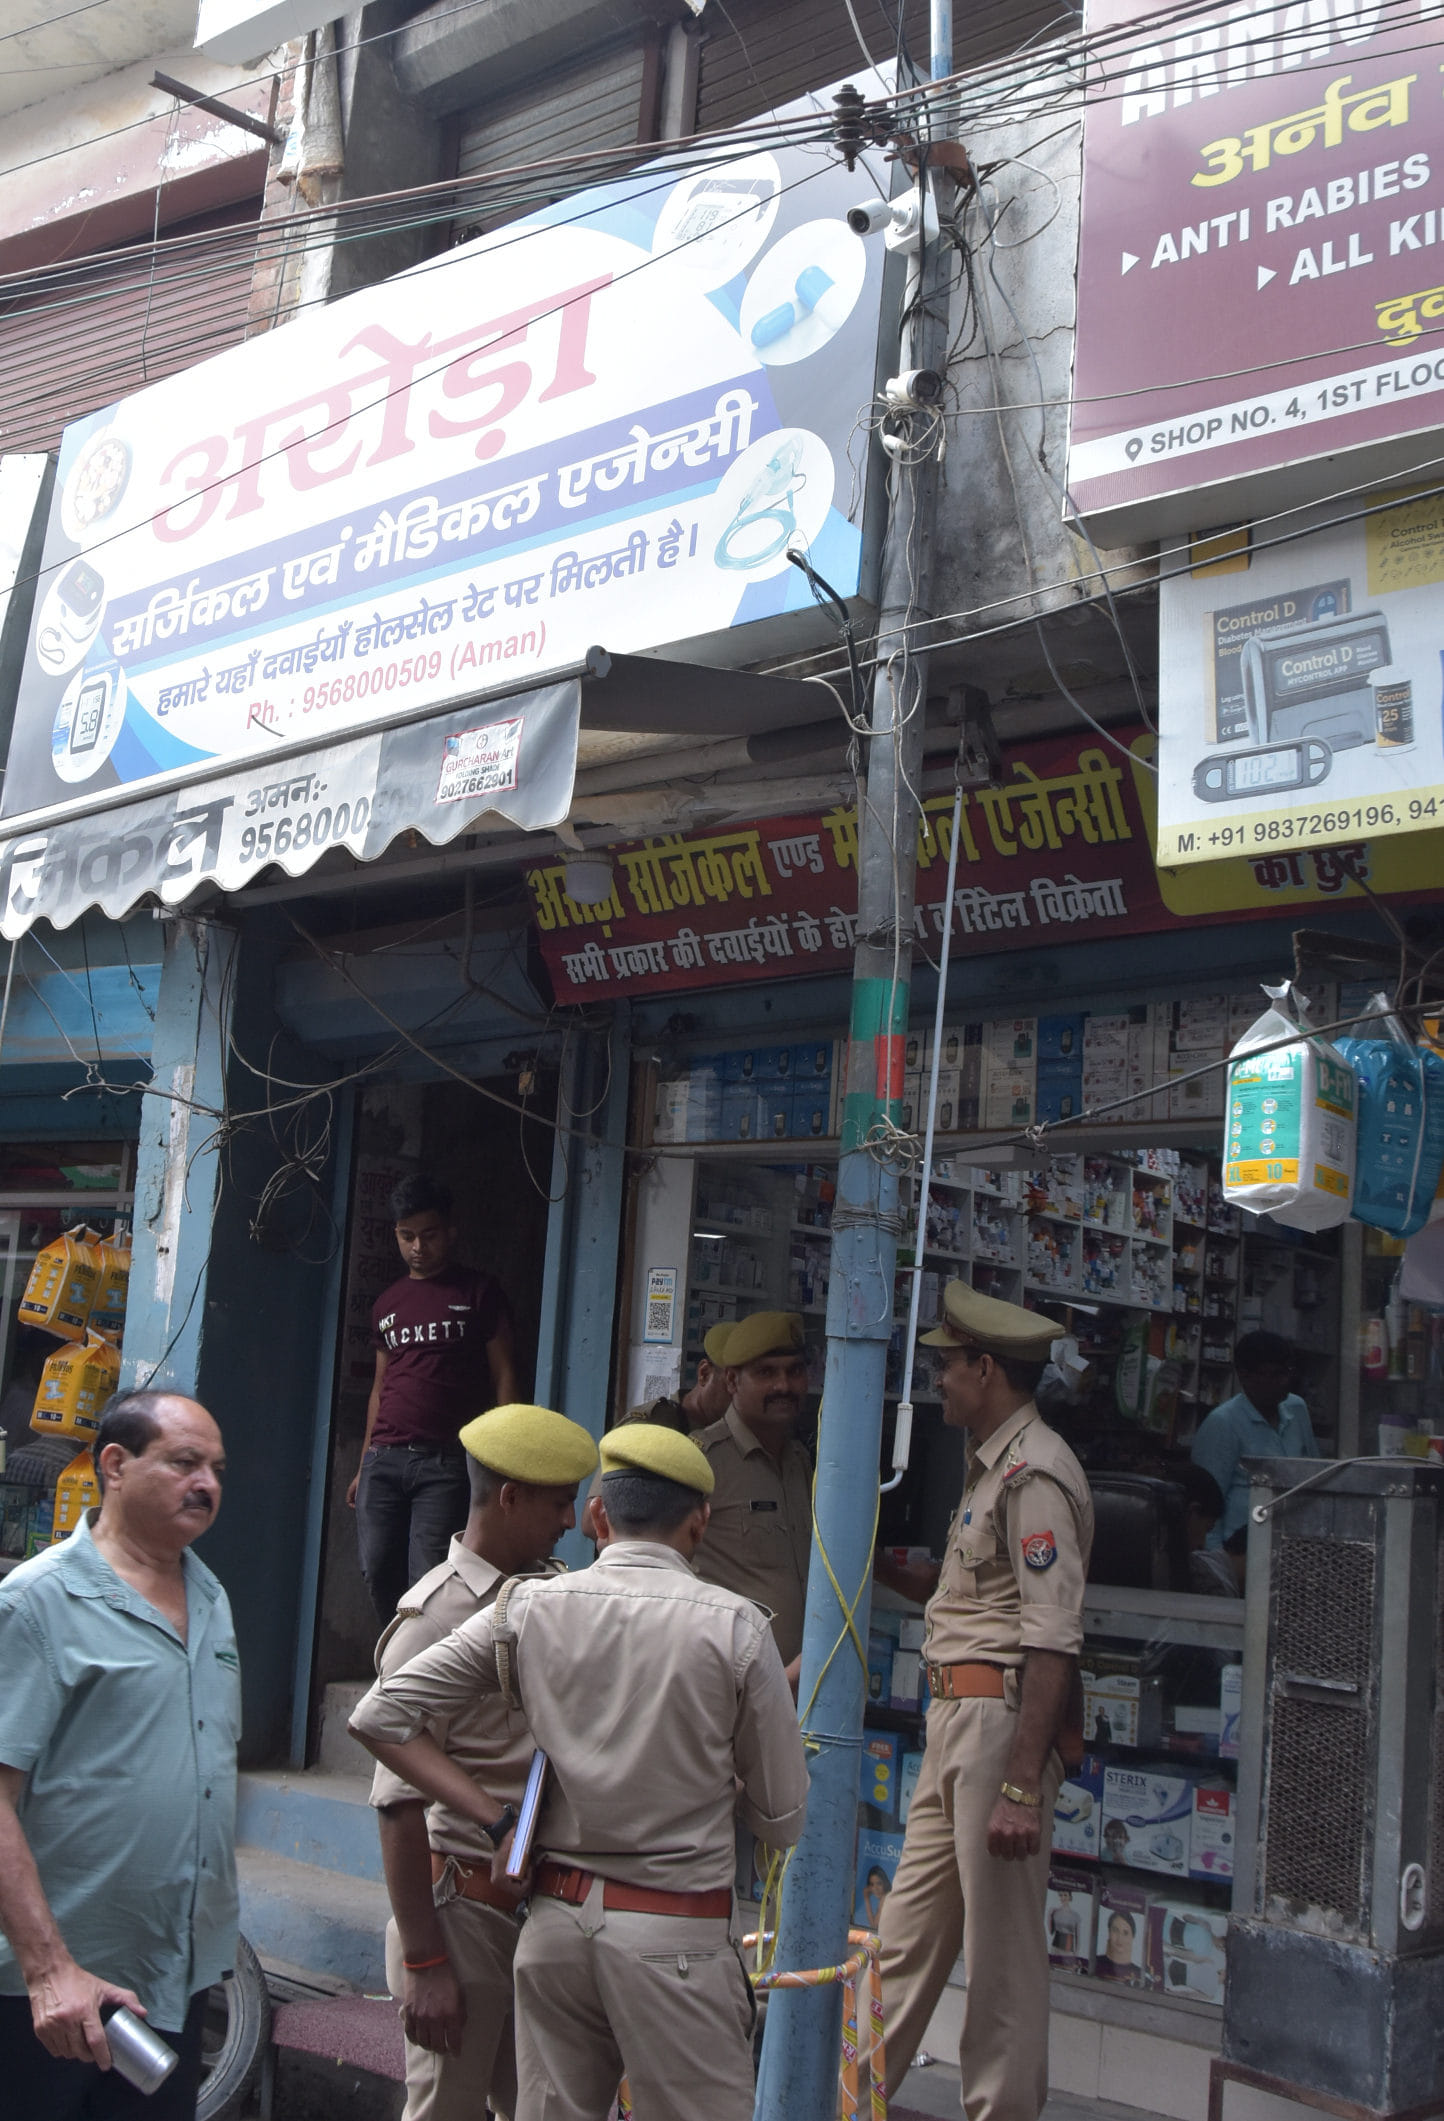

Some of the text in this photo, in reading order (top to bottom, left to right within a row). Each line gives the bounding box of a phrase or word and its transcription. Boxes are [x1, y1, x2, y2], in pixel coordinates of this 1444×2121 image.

[1189, 75, 1418, 187] अर्नव
[1150, 153, 1430, 269] ANTI RABIES
[1289, 207, 1444, 285] ALL KI
[152, 272, 613, 543] अरोड़ा
[1150, 418, 1223, 453] SHOP
[1231, 406, 1277, 434] NO.
[1285, 397, 1307, 421] 4,
[1317, 379, 1367, 410] 1ST
[112, 389, 759, 656] सर्जिकल एवं मैडिकल एजेन्सी
[157, 668, 211, 716] हमारे
[216, 649, 262, 694] यहाँ
[354, 598, 457, 657] होलसेल
[462, 583, 498, 623] रेट
[504, 572, 544, 609] पर
[550, 530, 650, 598] मिलती
[1217, 601, 1296, 632] Control D
[302, 650, 442, 713] 9568000509
[450, 620, 546, 680] (Aman)
[1282, 649, 1338, 676] Control
[1340, 646, 1352, 662] D
[1382, 709, 1399, 722] 25
[446, 750, 499, 773] GURCHARAN
[768, 834, 824, 878] एण्ड
[975, 748, 1133, 856] एजेन्सी
[1178, 833, 1201, 853] M:
[1208, 826, 1245, 847] +91
[1253, 804, 1401, 842] 9837269196,
[562, 942, 610, 984] सभी
[608, 940, 669, 979] प्रकार
[667, 928, 704, 969] की
[704, 912, 793, 966] दवाईयों
[793, 911, 823, 953] के
[1030, 874, 1128, 925] विक्रेता
[1266, 1163, 1283, 1180] 10
[908, 1762, 920, 1771] Acc
[1107, 1771, 1146, 1787] STERIX
[864, 1841, 900, 1858] AccuSu
